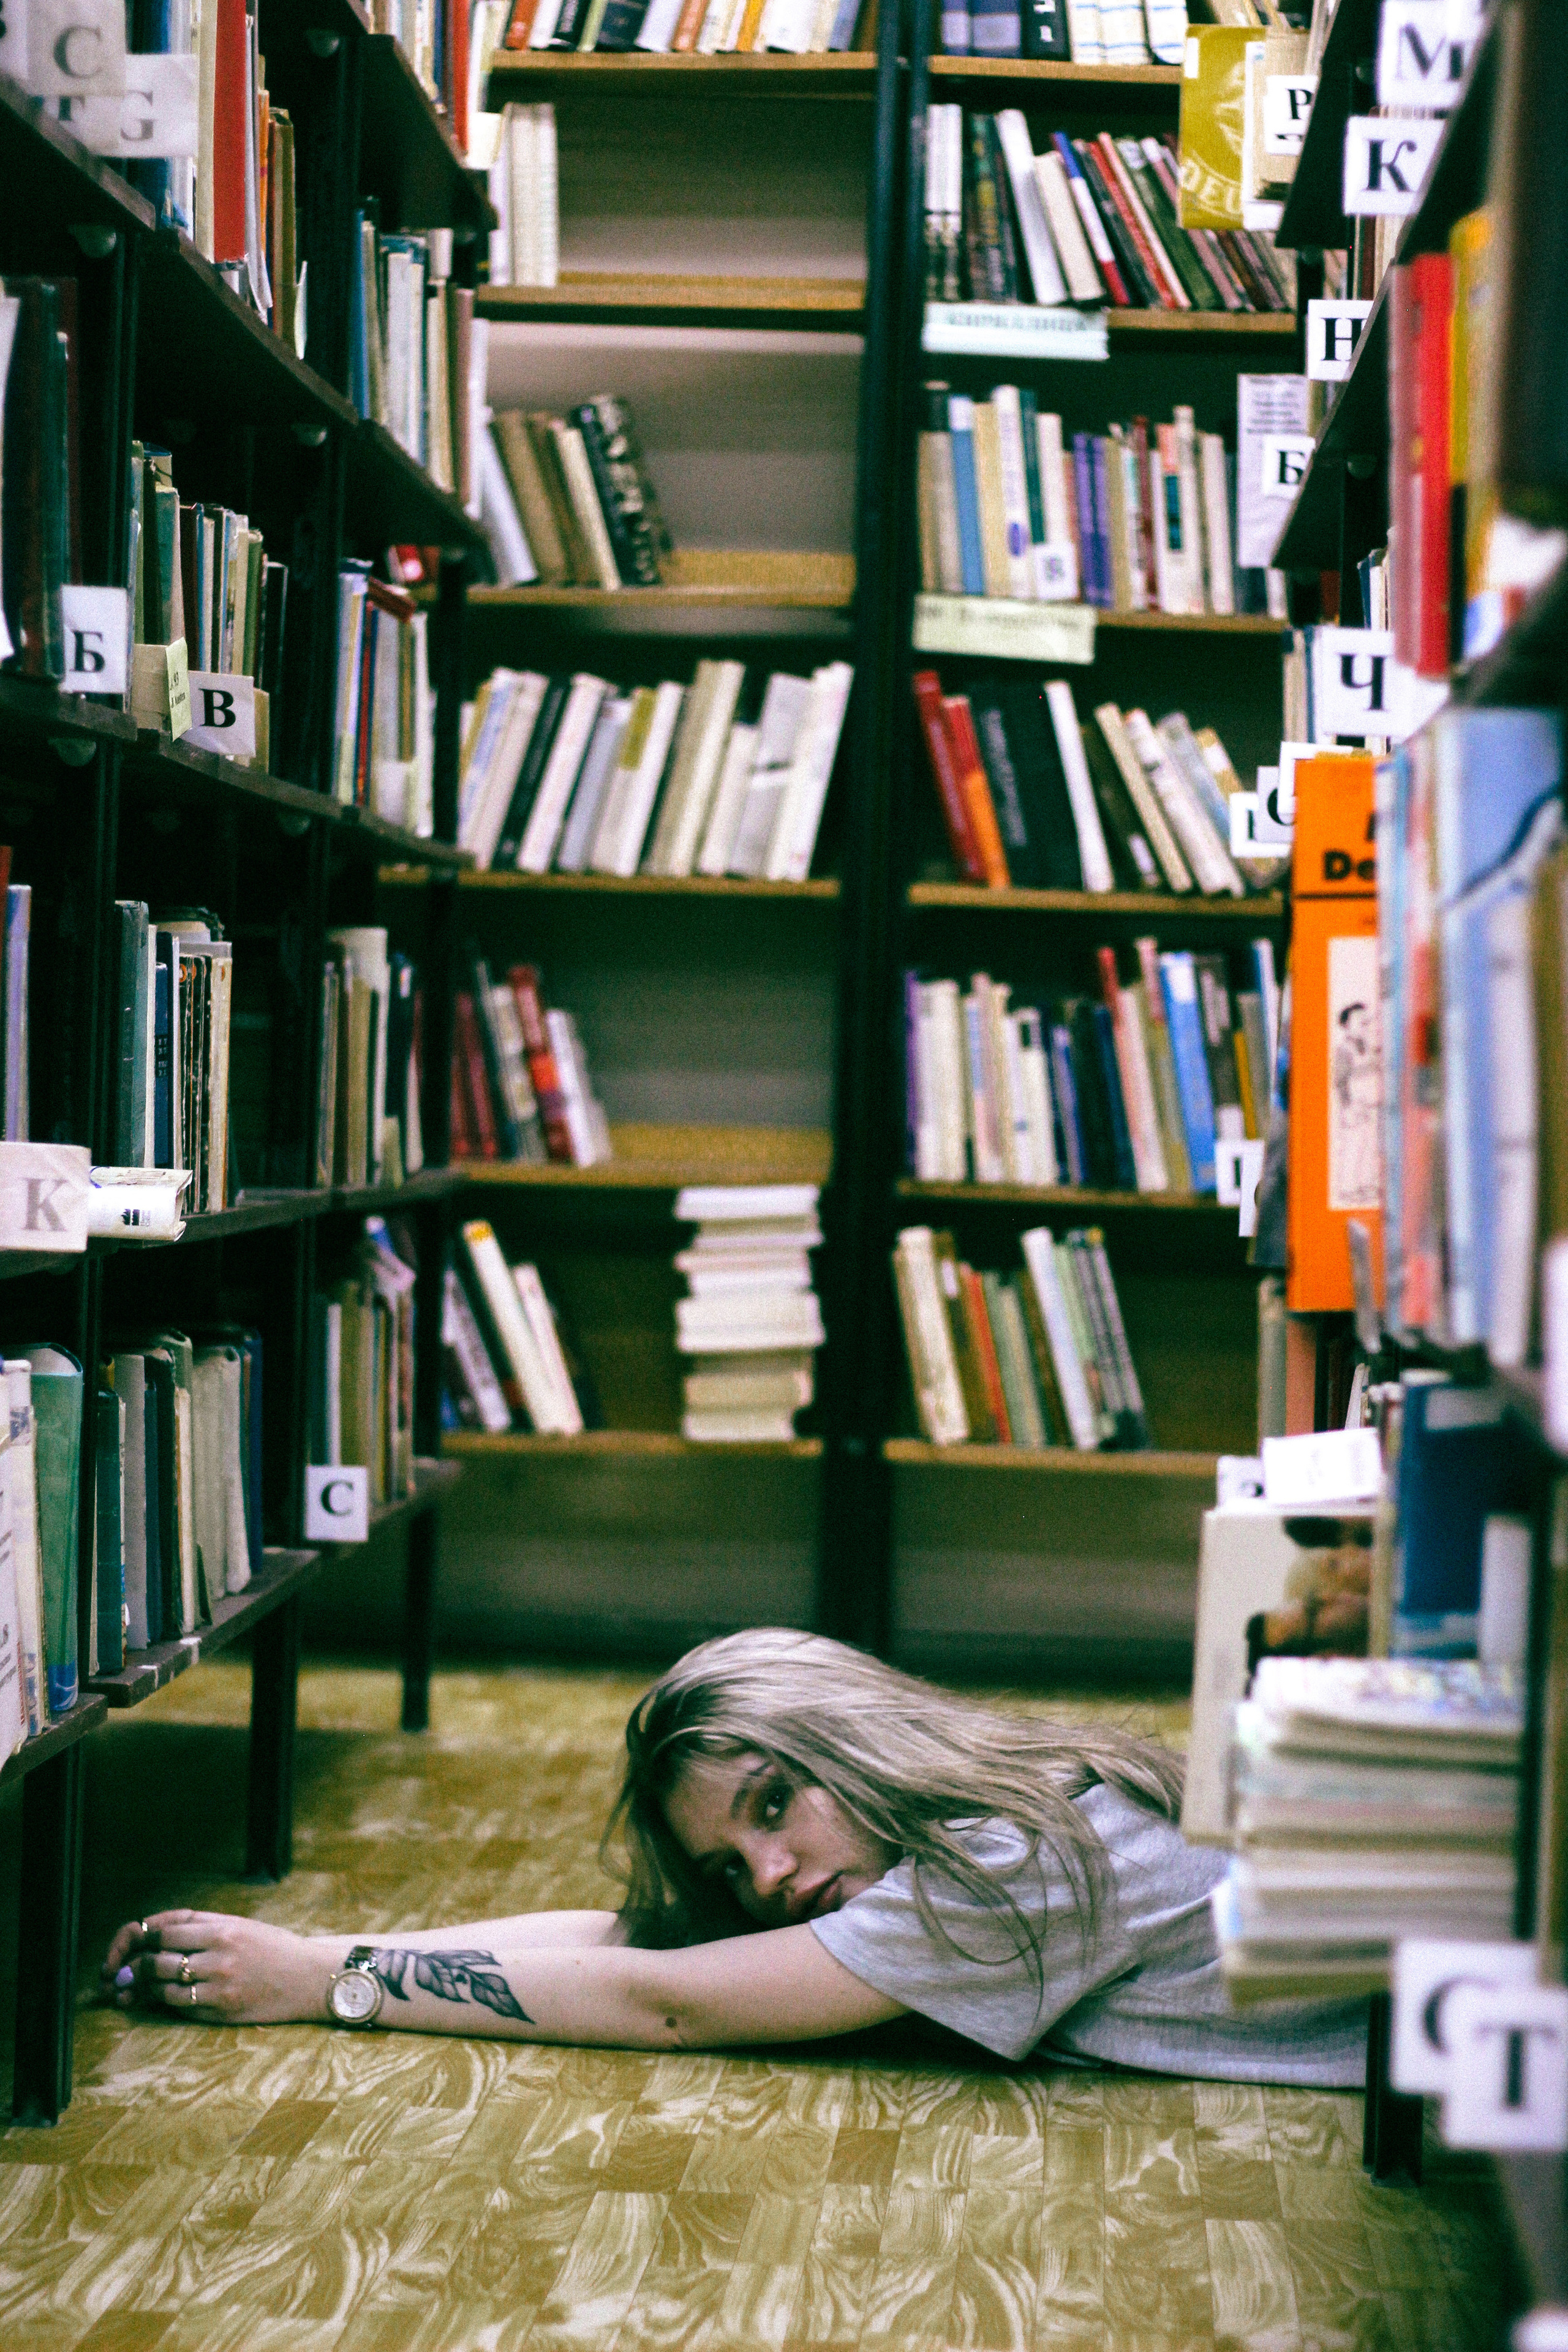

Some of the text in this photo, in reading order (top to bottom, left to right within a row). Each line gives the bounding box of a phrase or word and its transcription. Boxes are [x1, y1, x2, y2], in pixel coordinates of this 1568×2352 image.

[1366, 138, 1417, 193] К
[1320, 317, 1365, 361] Н
[1278, 450, 1305, 486] Б
[71, 629, 106, 674] Б
[1339, 653, 1389, 712] Ч
[200, 688, 236, 728] В
[23, 1177, 69, 1233] K
[320, 1479, 354, 1517] С
